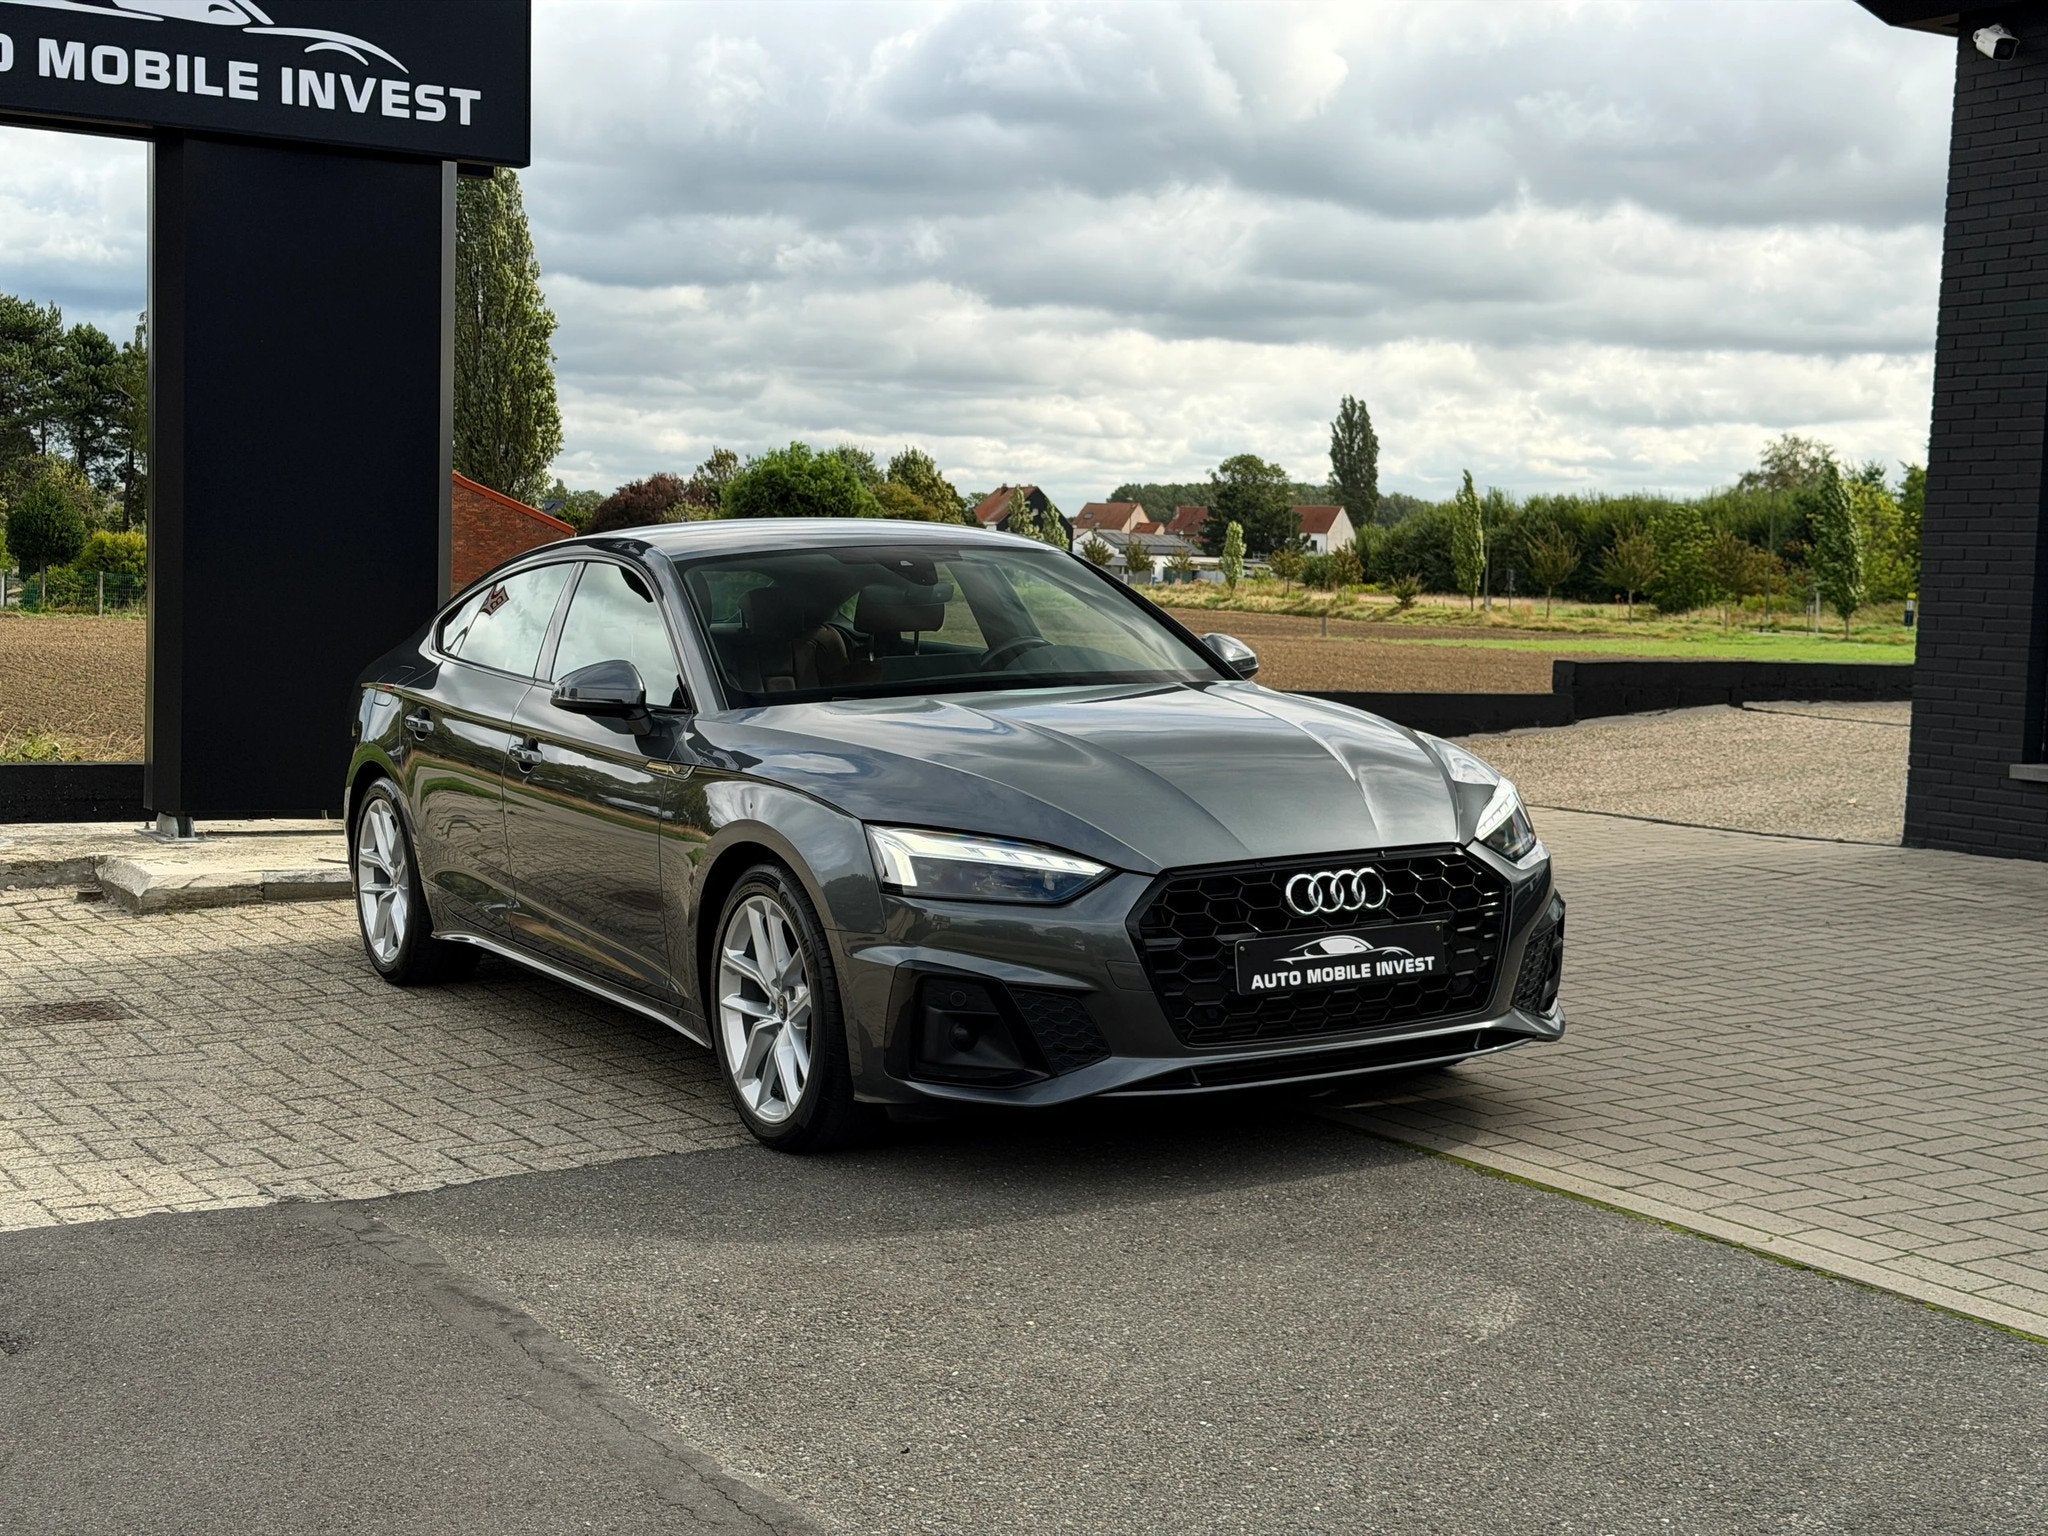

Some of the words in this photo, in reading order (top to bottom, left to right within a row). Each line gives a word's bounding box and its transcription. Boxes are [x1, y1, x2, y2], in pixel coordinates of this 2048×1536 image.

[38, 37, 259, 101] MOBILE
[281, 66, 482, 126] INVEST
[1251, 970, 1301, 990] AUTO
[1306, 963, 1371, 984] MOBILE
[1376, 956, 1435, 976] INVEST
